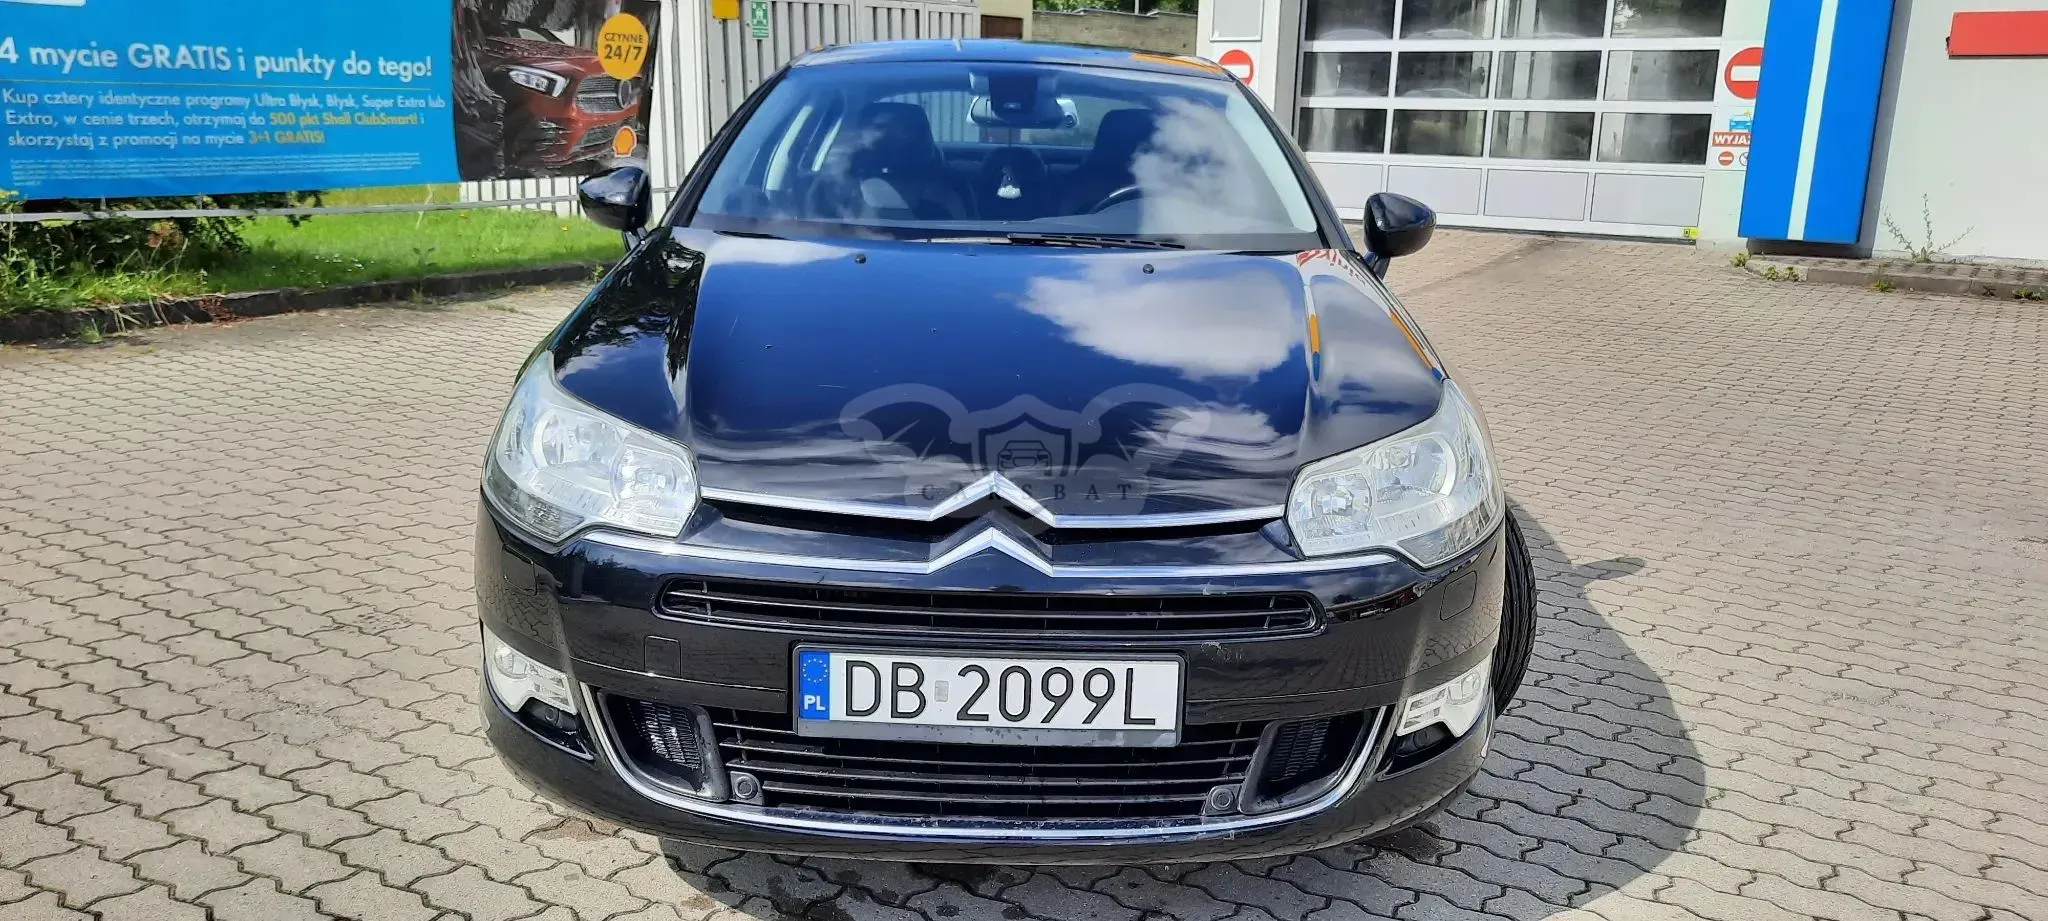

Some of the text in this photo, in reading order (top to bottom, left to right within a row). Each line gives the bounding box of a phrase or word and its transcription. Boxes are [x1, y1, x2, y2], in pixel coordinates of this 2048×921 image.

[604, 33, 643, 43] CZYNNE
[0, 36, 433, 82] 4 mycie GRATIS i punkty do tego!
[604, 44, 643, 63] 24/7
[2, 88, 39, 109] Kup
[44, 92, 94, 109] cztery
[99, 90, 181, 108] identyczne
[185, 95, 251, 110] programy
[254, 92, 286, 107] Ultra
[361, 94, 394, 111] Super
[397, 95, 426, 108] Extra
[428, 94, 446, 108] lub
[6, 110, 58, 127] Extra,
[64, 114, 77, 125] w
[82, 112, 124, 126] cenie
[128, 109, 179, 127] trzech,
[183, 112, 247, 129] otrzymaj
[248, 111, 266, 126] do
[269, 111, 296, 126] 500
[300, 112, 320, 129] pkt
[323, 112, 351, 126] Shell
[8, 130, 94, 150] skorzystaj
[98, 137, 109, 146] z
[113, 132, 178, 149] promocji
[182, 135, 201, 145] na
[205, 131, 245, 149] mycie
[844, 659, 1157, 726] DB 2099L
[803, 694, 827, 712] PL
